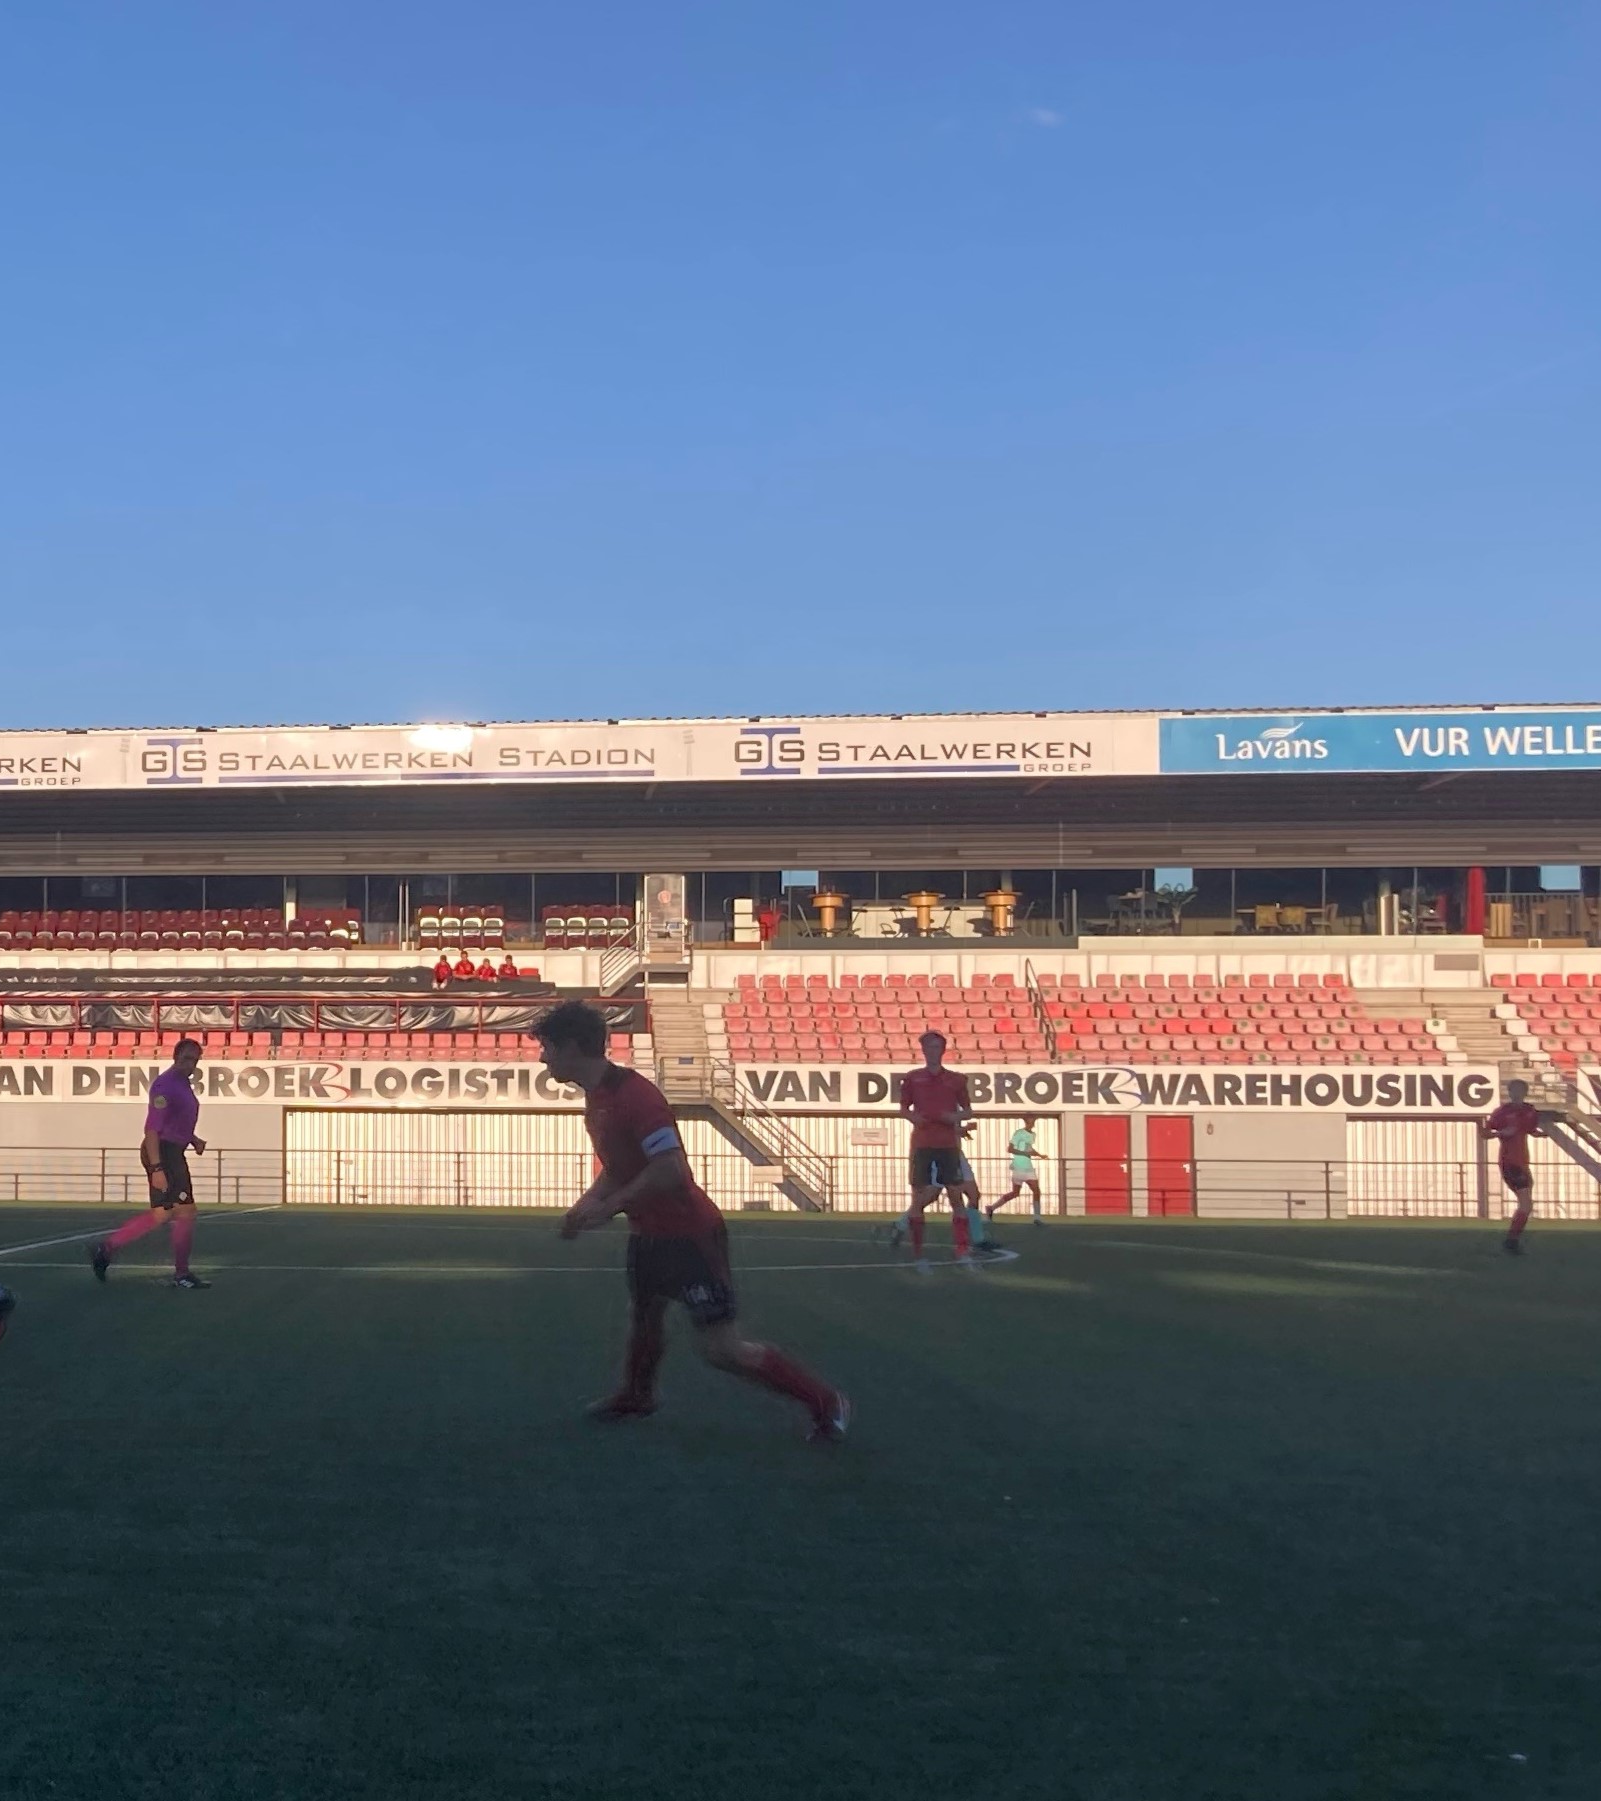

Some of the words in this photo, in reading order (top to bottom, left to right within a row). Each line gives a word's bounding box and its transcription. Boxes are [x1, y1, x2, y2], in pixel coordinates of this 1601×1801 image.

[817, 741, 1092, 762] STAALWERKEN
[1216, 732, 1328, 760] Lavans
[1395, 726, 1469, 757] VUR
[1483, 725, 1601, 756] WELLE
[218, 752, 474, 773] STAALWERKEN
[498, 747, 655, 767] STADION
[1023, 763, 1092, 773] GROEP
[20, 777, 81, 786] GROEP
[72, 1065, 160, 1097] DEN
[190, 1066, 331, 1099] BROEK
[744, 1070, 842, 1103] VAN
[966, 1072, 1121, 1105] BROEK
[1135, 1073, 1494, 1107] WAREHOUSING
